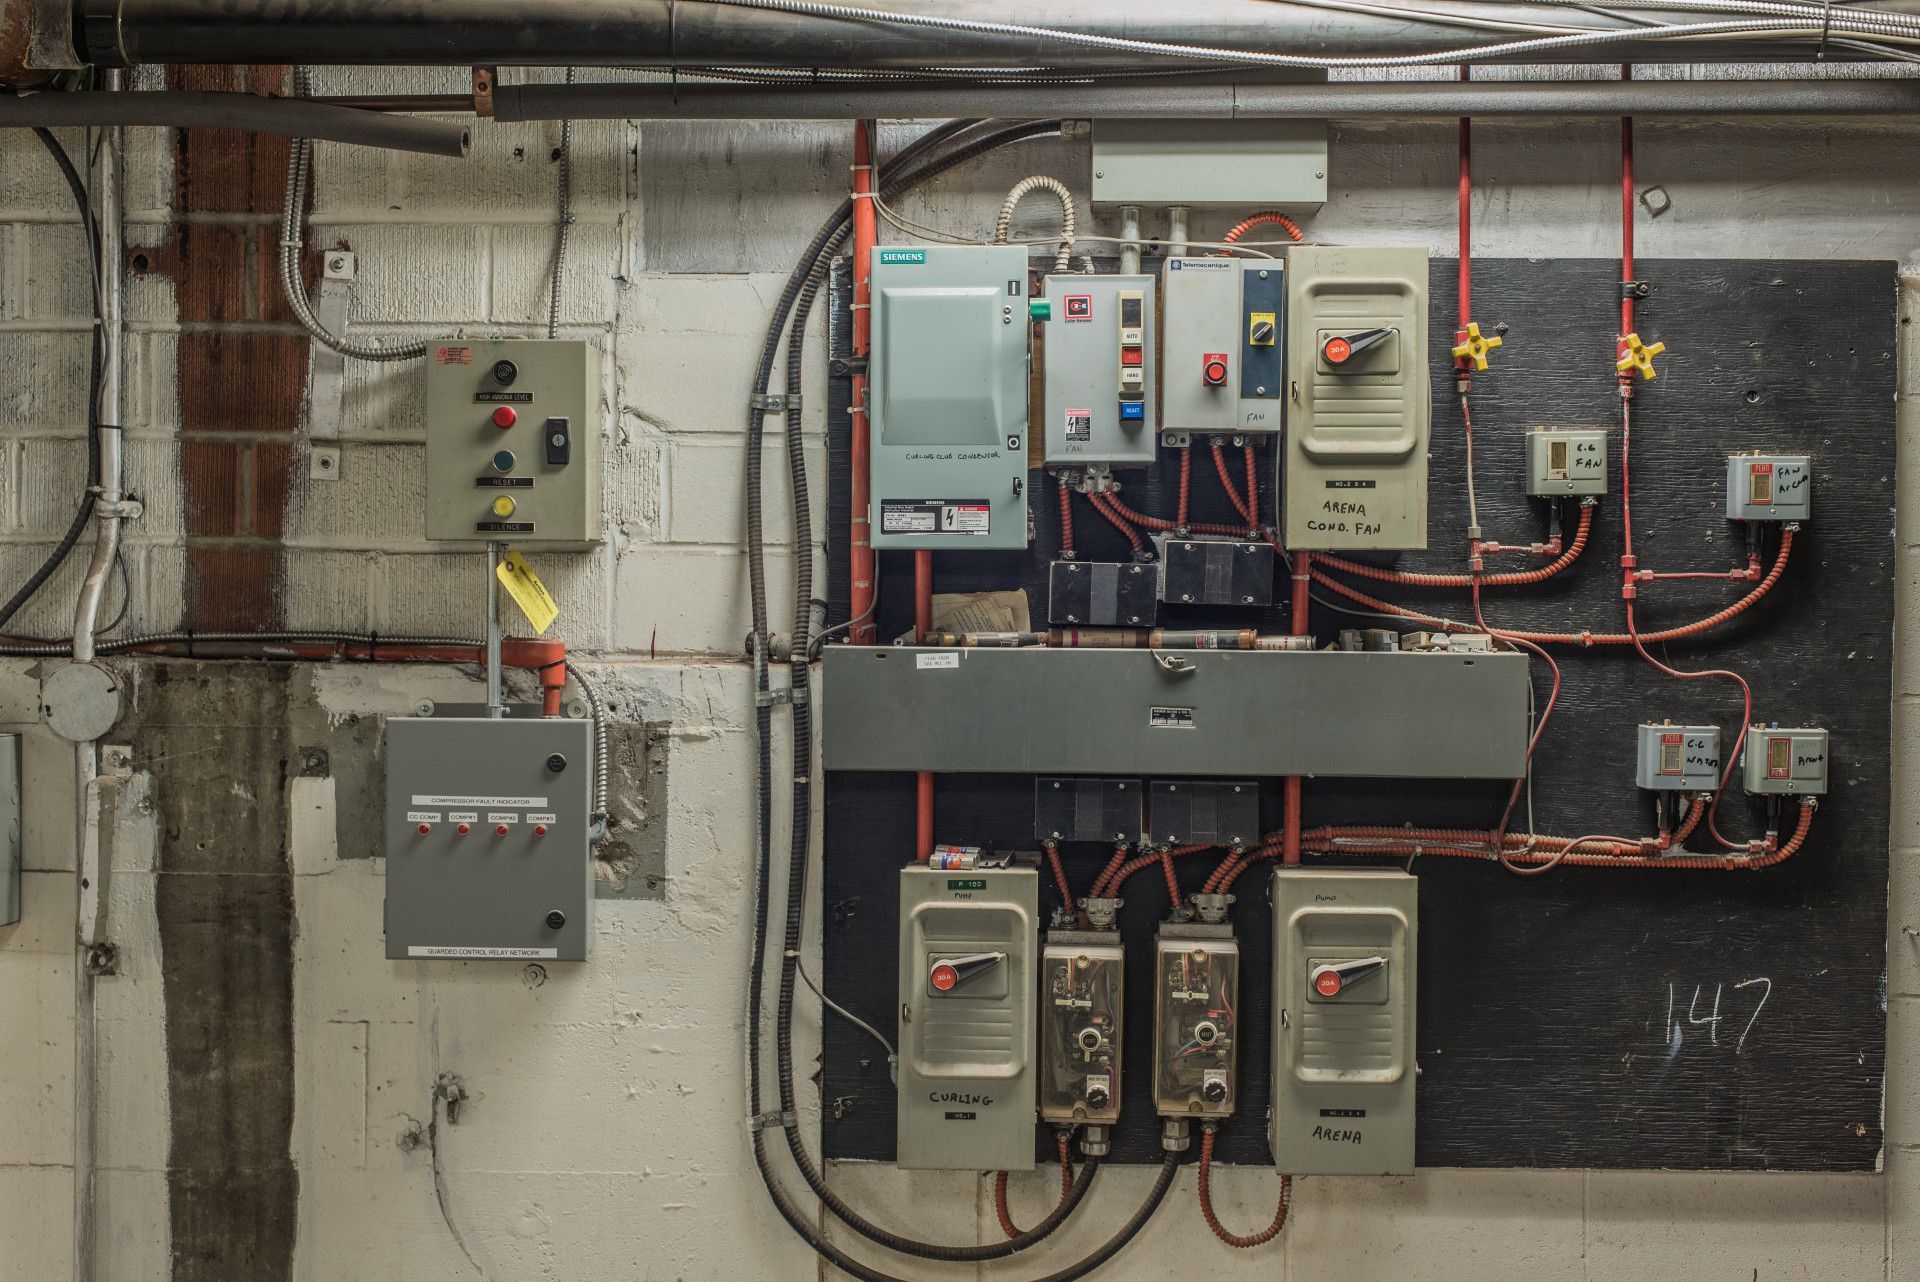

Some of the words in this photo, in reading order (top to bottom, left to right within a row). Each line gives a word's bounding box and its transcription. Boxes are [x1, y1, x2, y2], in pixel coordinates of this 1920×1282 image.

[883, 253, 923, 261] SIEMENS
[1330, 346, 1345, 354] 30A
[1246, 412, 1265, 424] FAN
[1575, 457, 1603, 469] FAN
[1322, 500, 1366, 517] ARENA
[489, 523, 520, 531] SILENCE
[1307, 520, 1349, 532] COND.
[1355, 522, 1381, 536] FAN
[496, 798, 530, 806] INDICATOR
[954, 892, 973, 900] PUMP
[1315, 894, 1337, 902] PUMP
[1666, 977, 1772, 1054] 147
[929, 1091, 994, 1106] CURLING
[1312, 1125, 1362, 1145] ARENA
